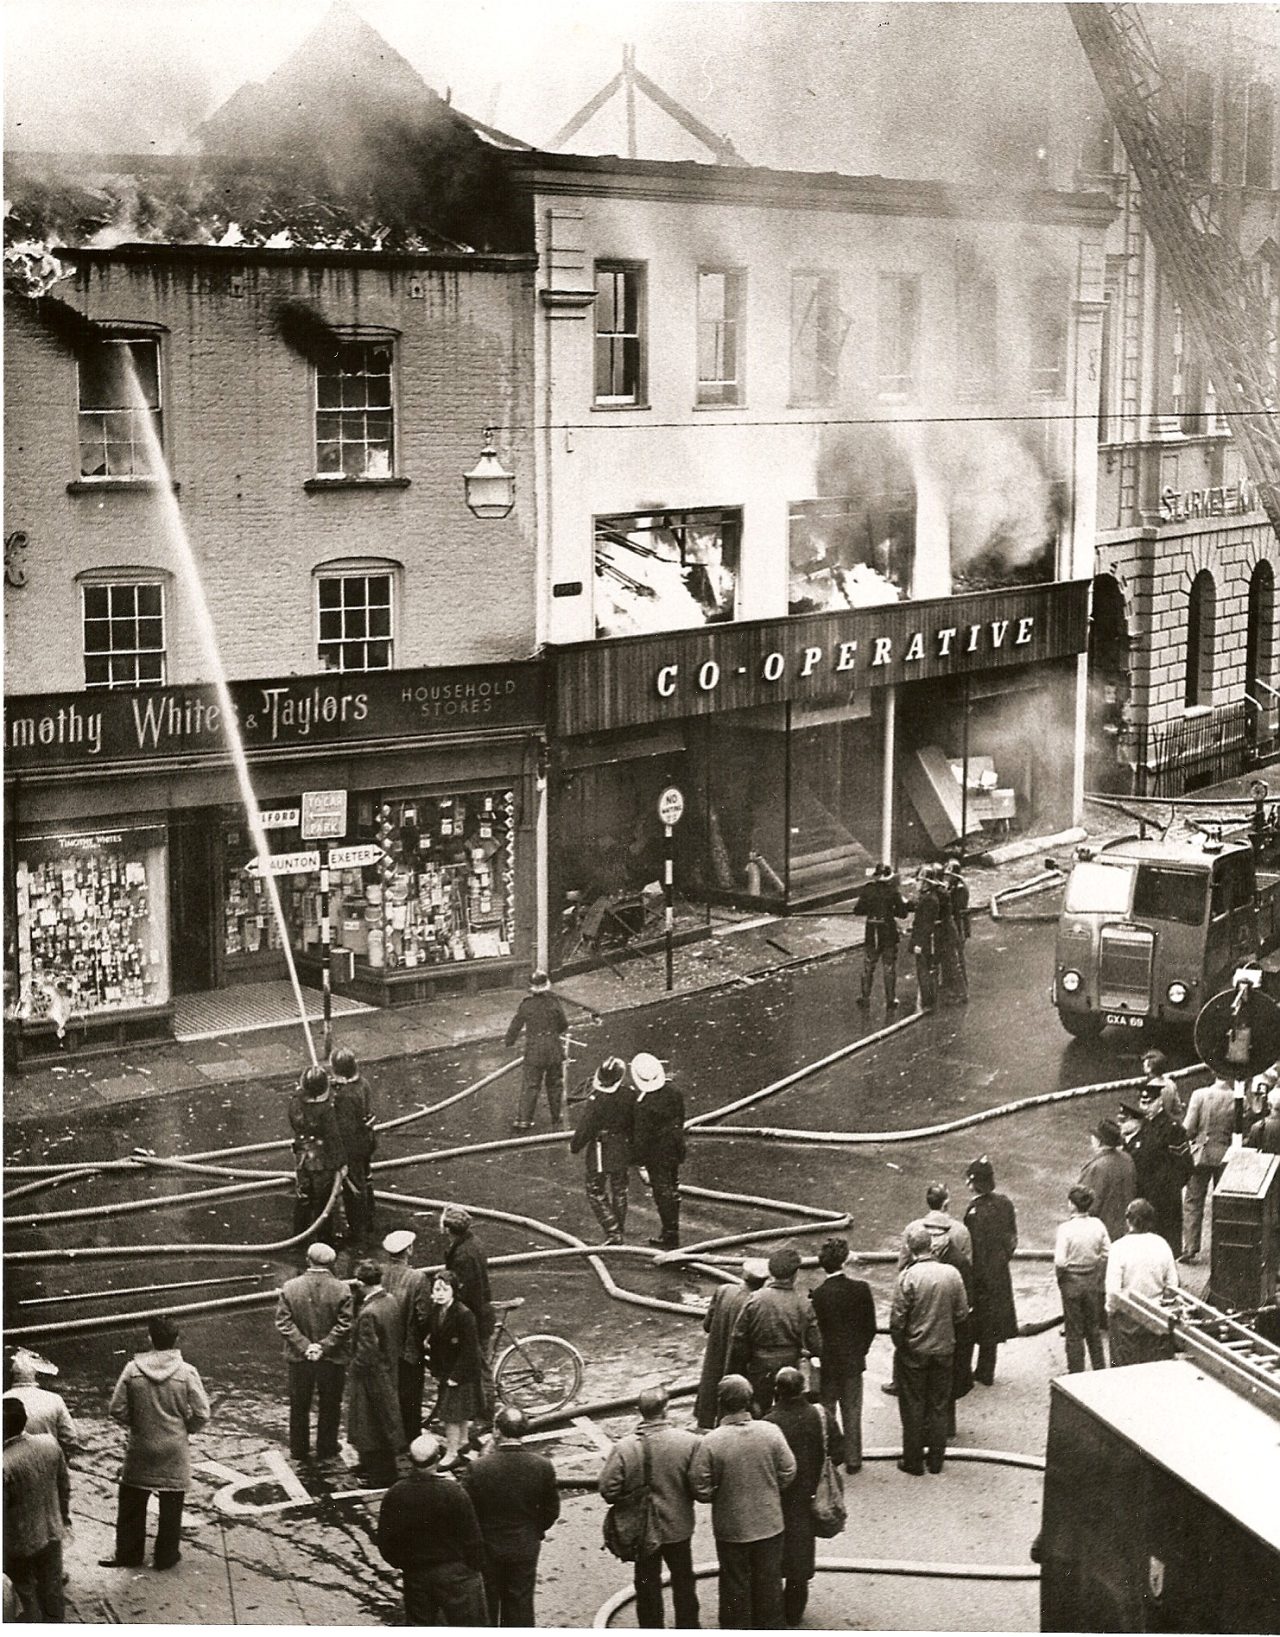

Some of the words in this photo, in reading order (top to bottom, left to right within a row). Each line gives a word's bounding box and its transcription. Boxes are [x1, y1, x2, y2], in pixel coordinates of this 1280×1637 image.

[656, 617, 1034, 697] CO-OPERATIVE
[401, 680, 515, 702] HOUSEHOLD
[421, 698, 492, 716] STORES
[132, 696, 238, 749] White
[246, 714, 257, 728] &
[262, 686, 368, 740] Taylors
[308, 797, 321, 807] TO
[666, 794, 678, 804] NO
[262, 811, 296, 822] LFORD
[310, 822, 339, 833] PARK
[269, 856, 317, 870] AUNTON
[331, 850, 371, 863] EXETER
